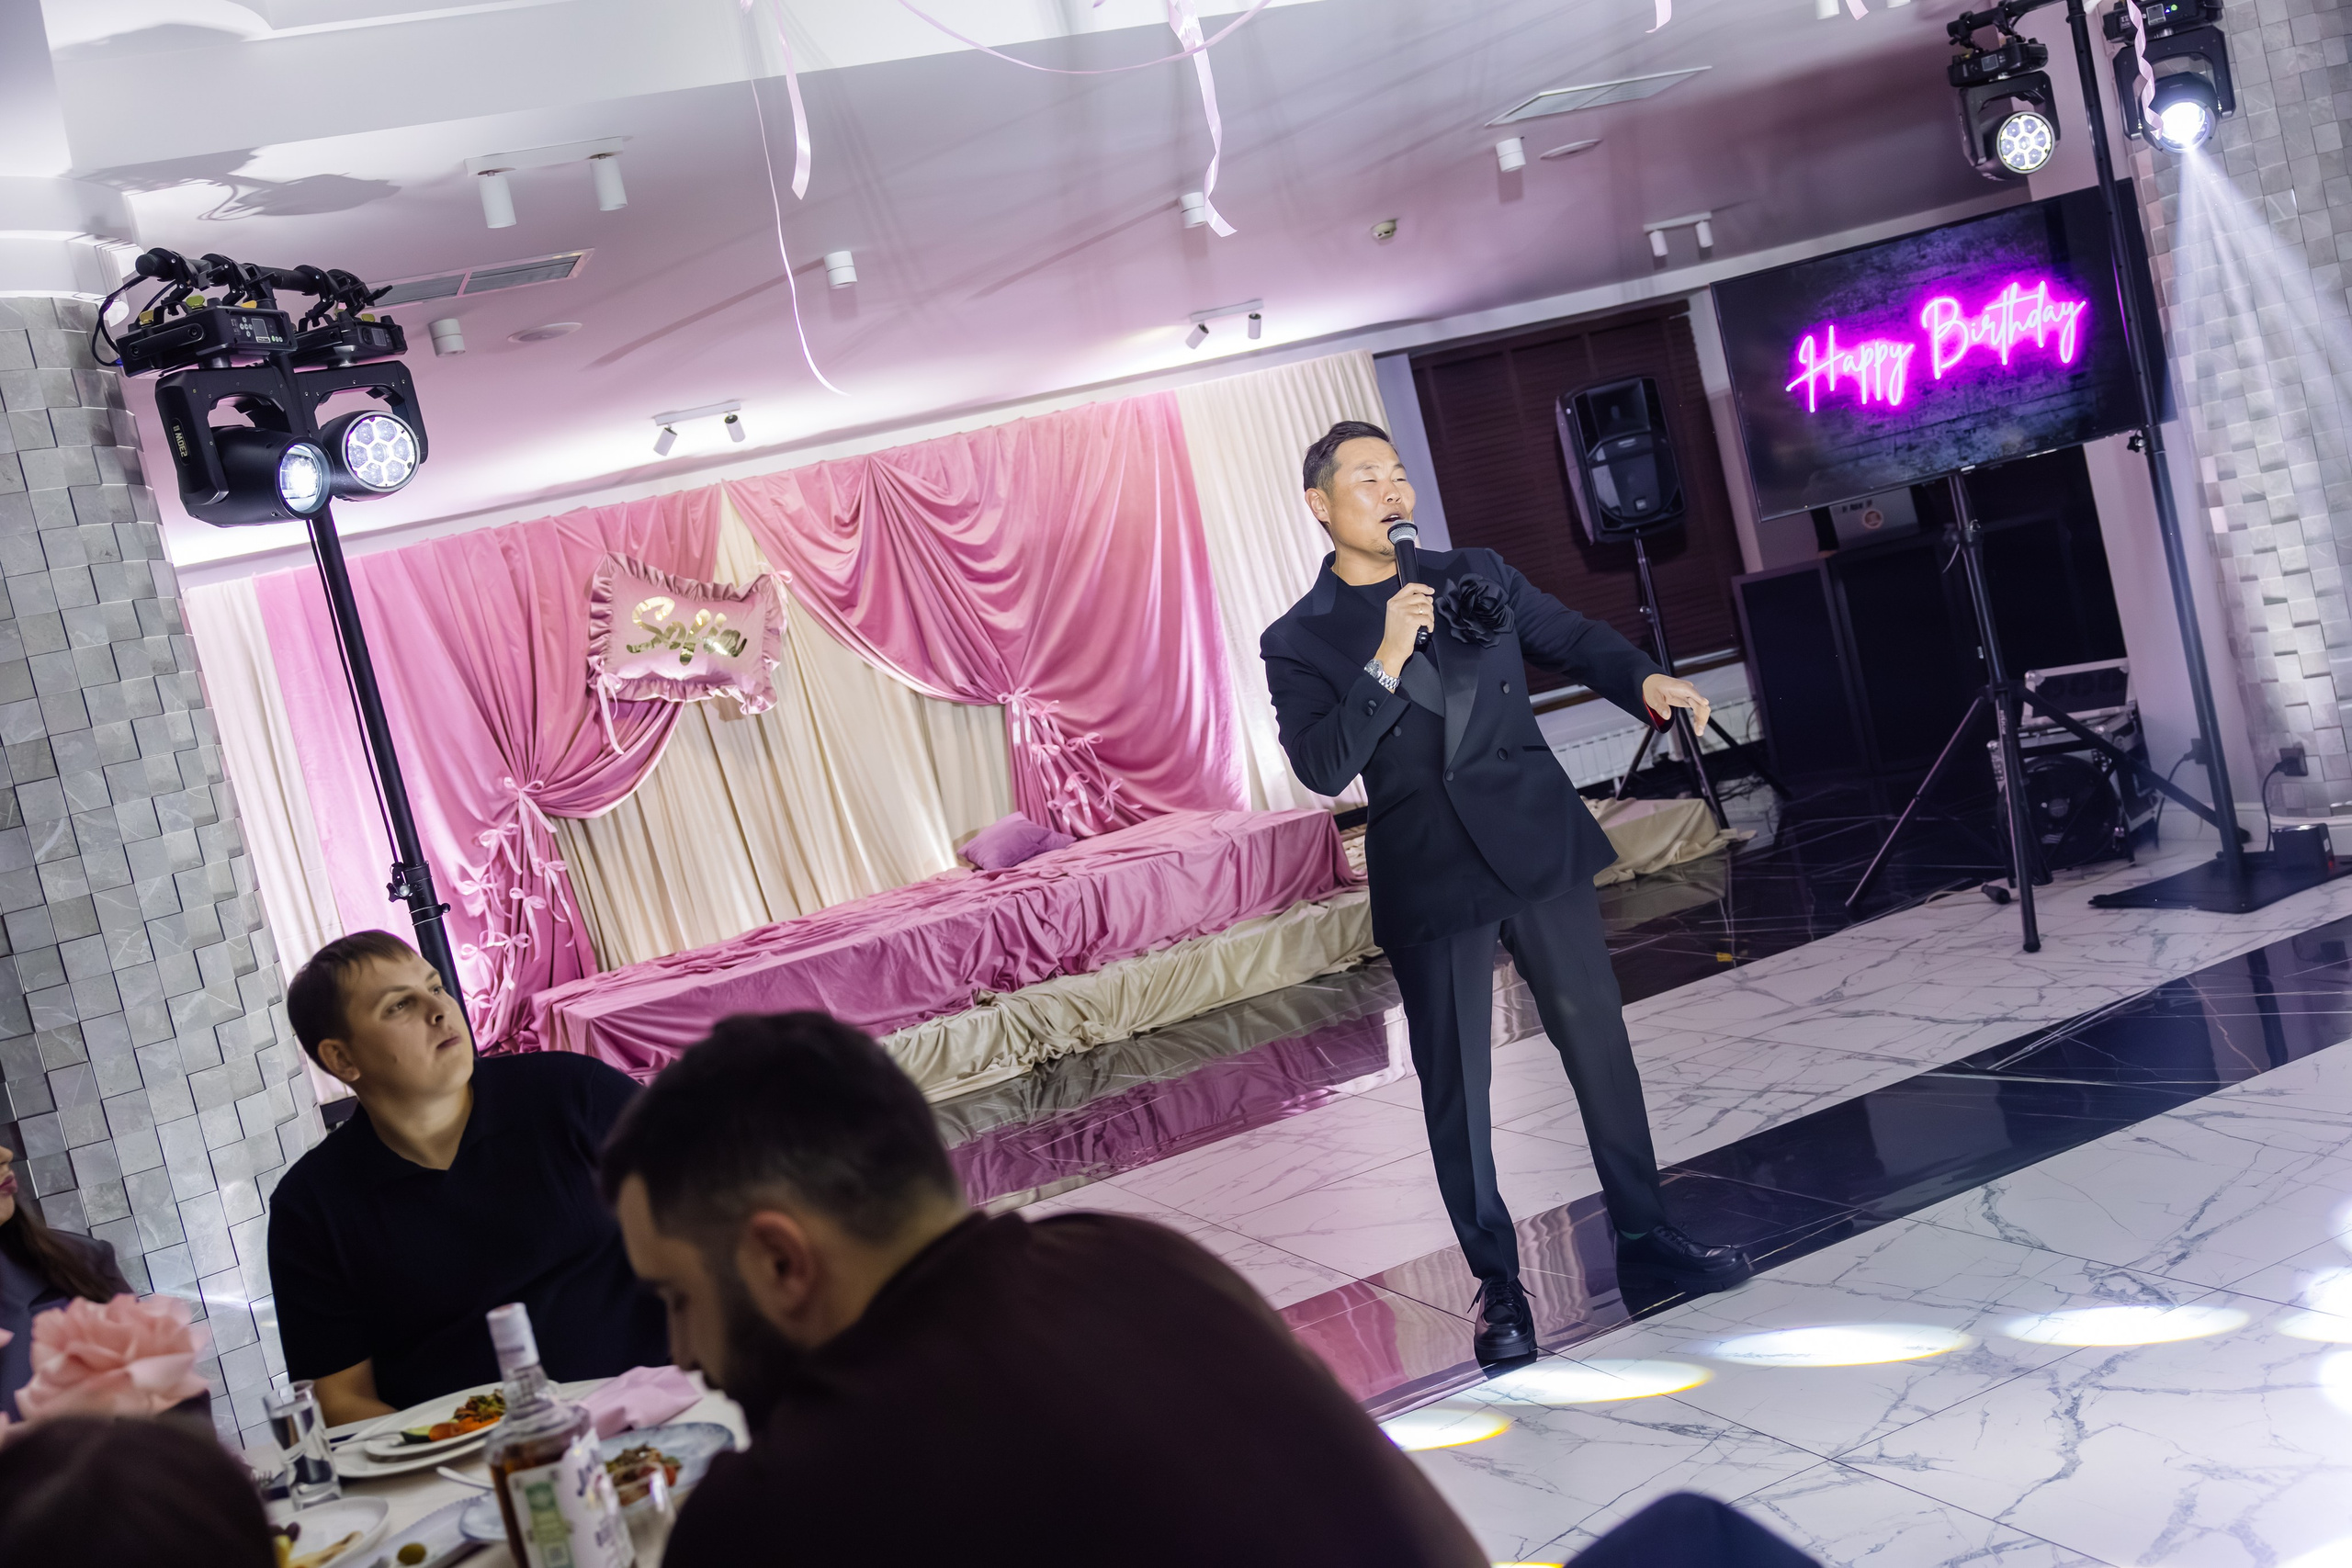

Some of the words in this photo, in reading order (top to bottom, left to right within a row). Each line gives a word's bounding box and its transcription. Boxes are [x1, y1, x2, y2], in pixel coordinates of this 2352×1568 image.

[1786, 325, 1914, 412] Happy
[1922, 281, 2086, 379] Birthday
[175, 433, 188, 457] 230W
[626, 596, 748, 666] Sofia
